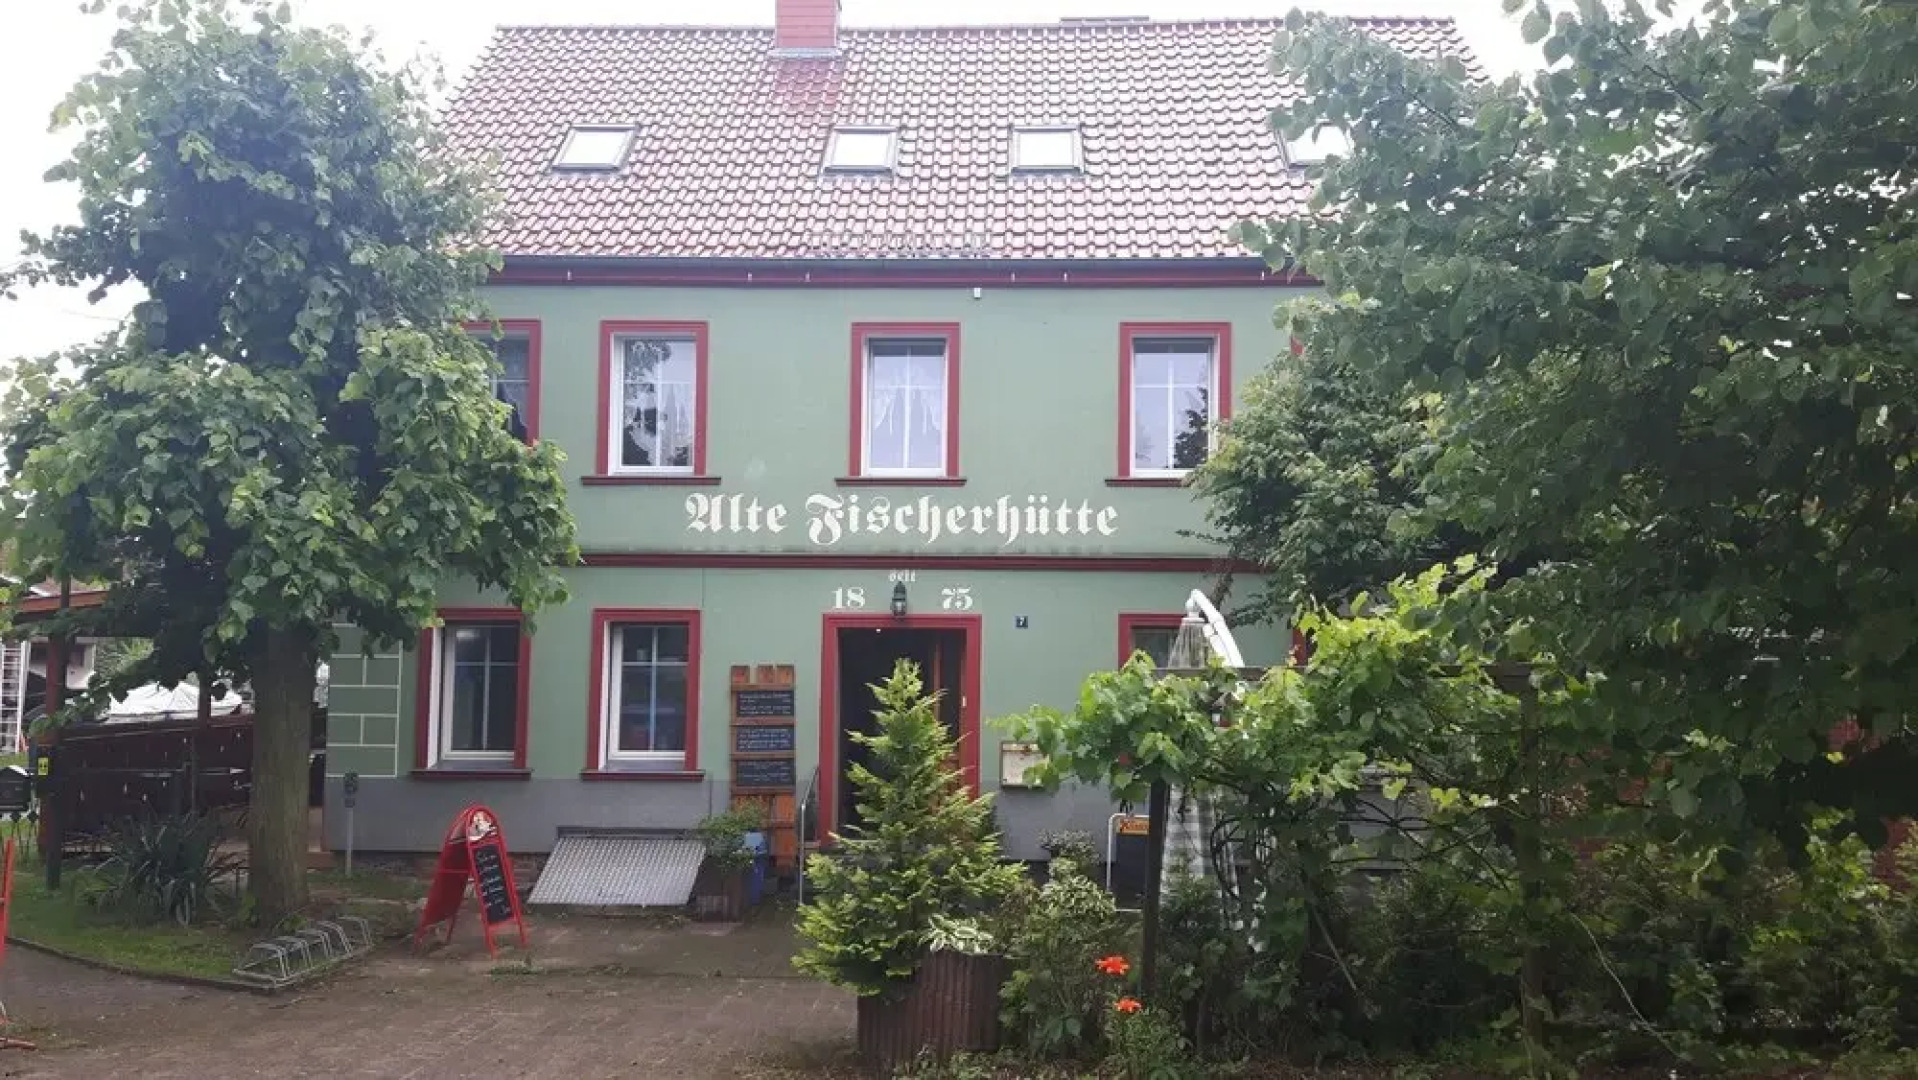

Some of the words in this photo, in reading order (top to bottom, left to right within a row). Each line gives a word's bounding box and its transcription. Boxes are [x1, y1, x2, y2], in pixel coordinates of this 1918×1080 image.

[685, 492, 787, 534] Alte
[805, 493, 1119, 547] Fischerhütte
[832, 587, 866, 609] 18
[941, 586, 974, 610] 75
